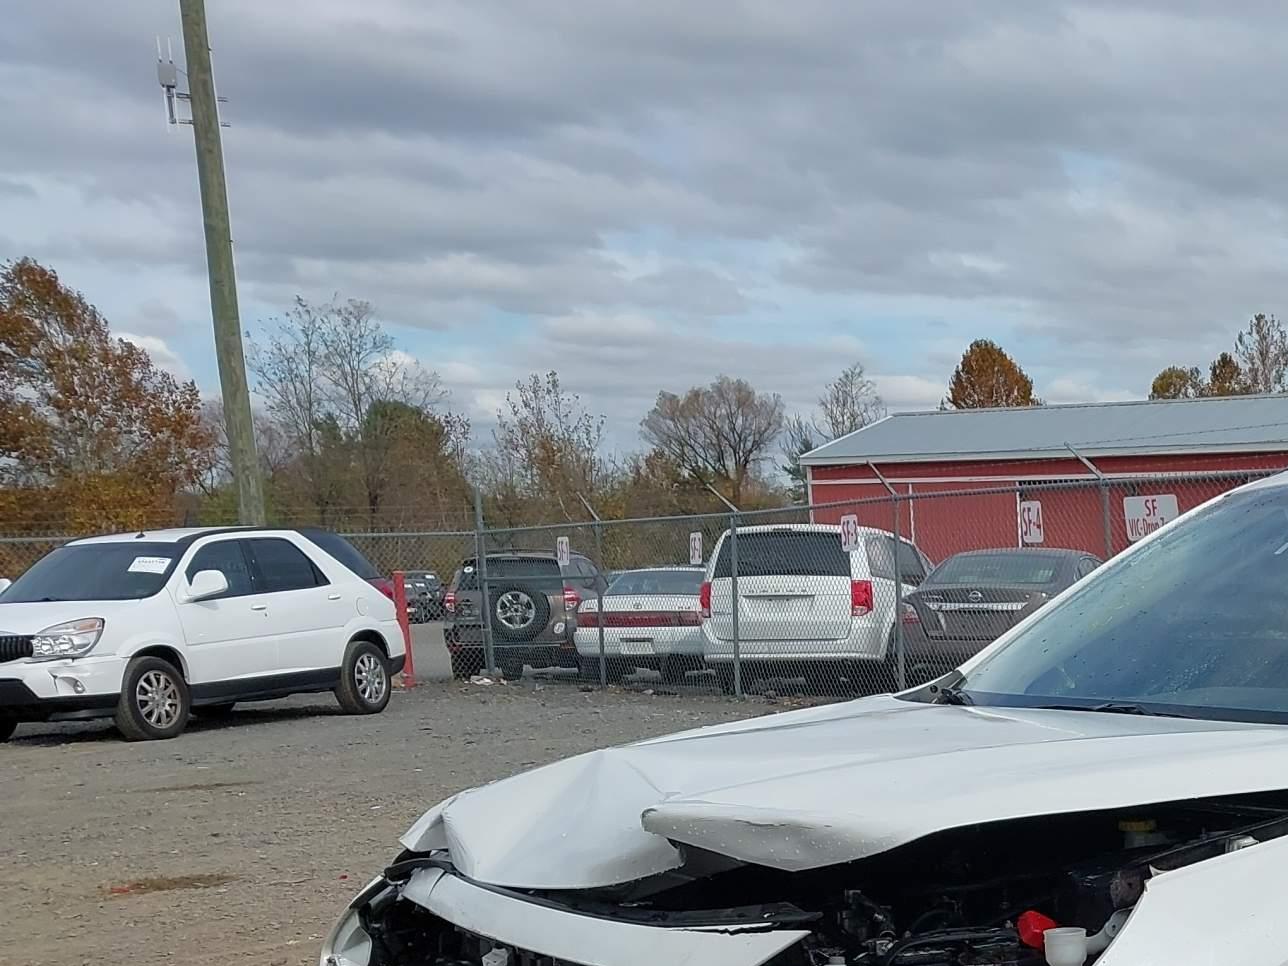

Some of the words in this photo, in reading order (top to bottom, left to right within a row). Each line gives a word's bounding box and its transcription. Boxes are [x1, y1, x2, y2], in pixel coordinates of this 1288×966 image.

[1022, 506, 1042, 537] SF-4
[1144, 499, 1158, 517] SF
[841, 518, 859, 546] SF-3
